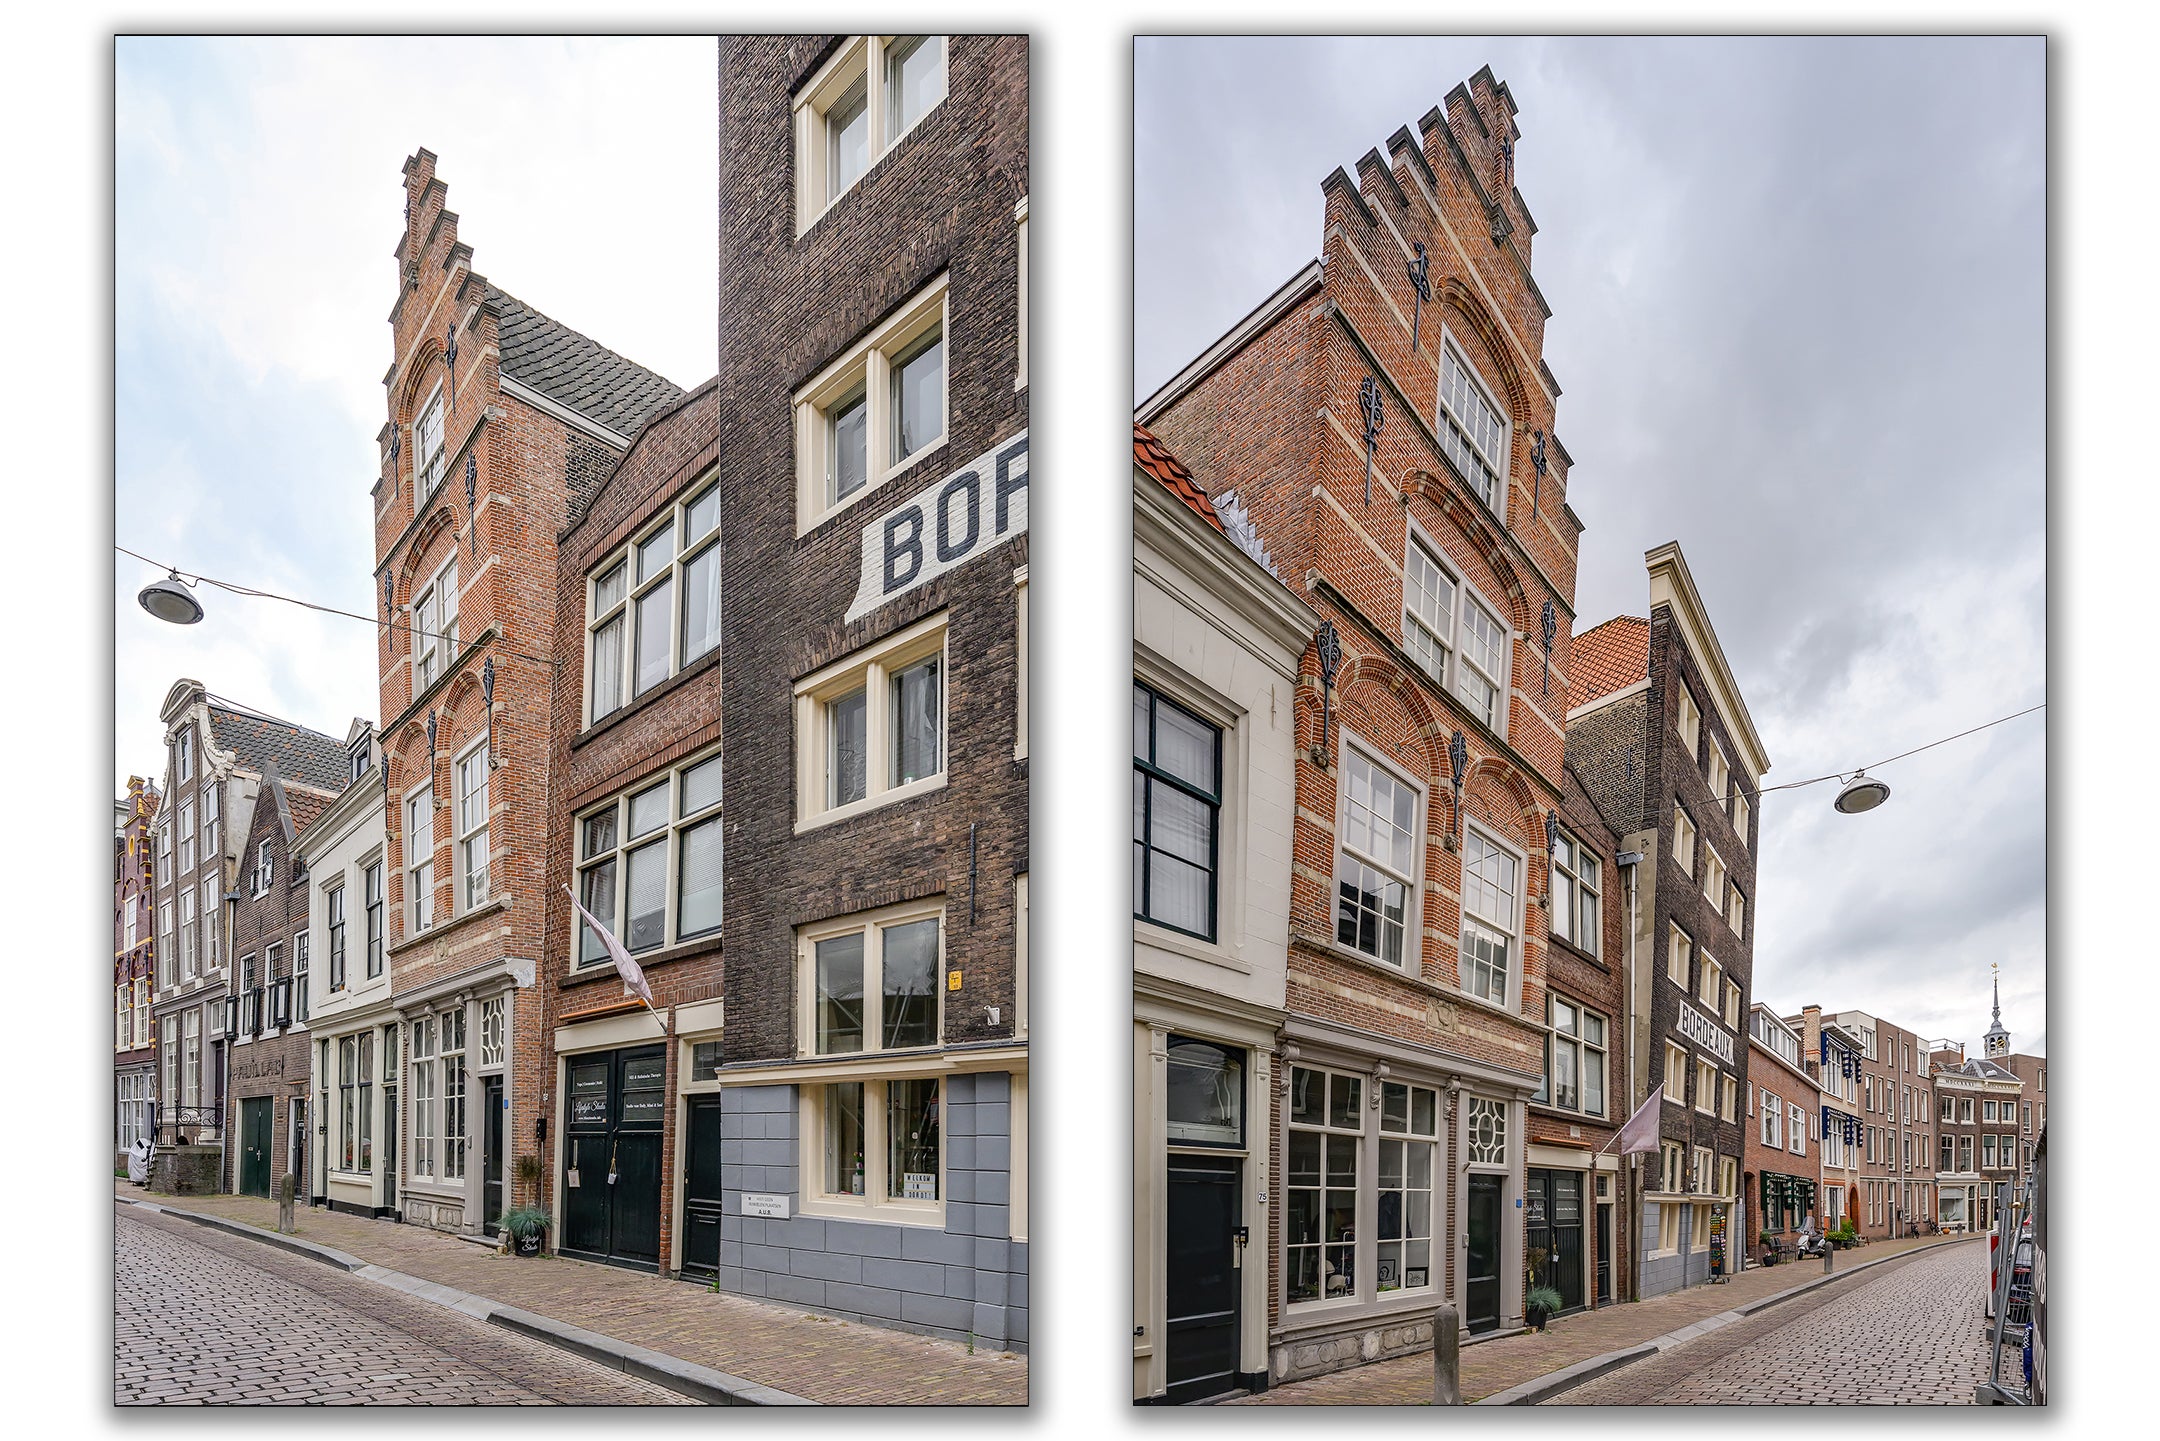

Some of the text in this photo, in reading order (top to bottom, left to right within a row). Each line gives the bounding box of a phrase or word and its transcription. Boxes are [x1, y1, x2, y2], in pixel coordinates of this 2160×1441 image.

[1682, 1003, 1732, 1062] BORDEAUX
[907, 1174, 931, 1182] WELKOM
[1259, 1192, 1267, 1200] 75
